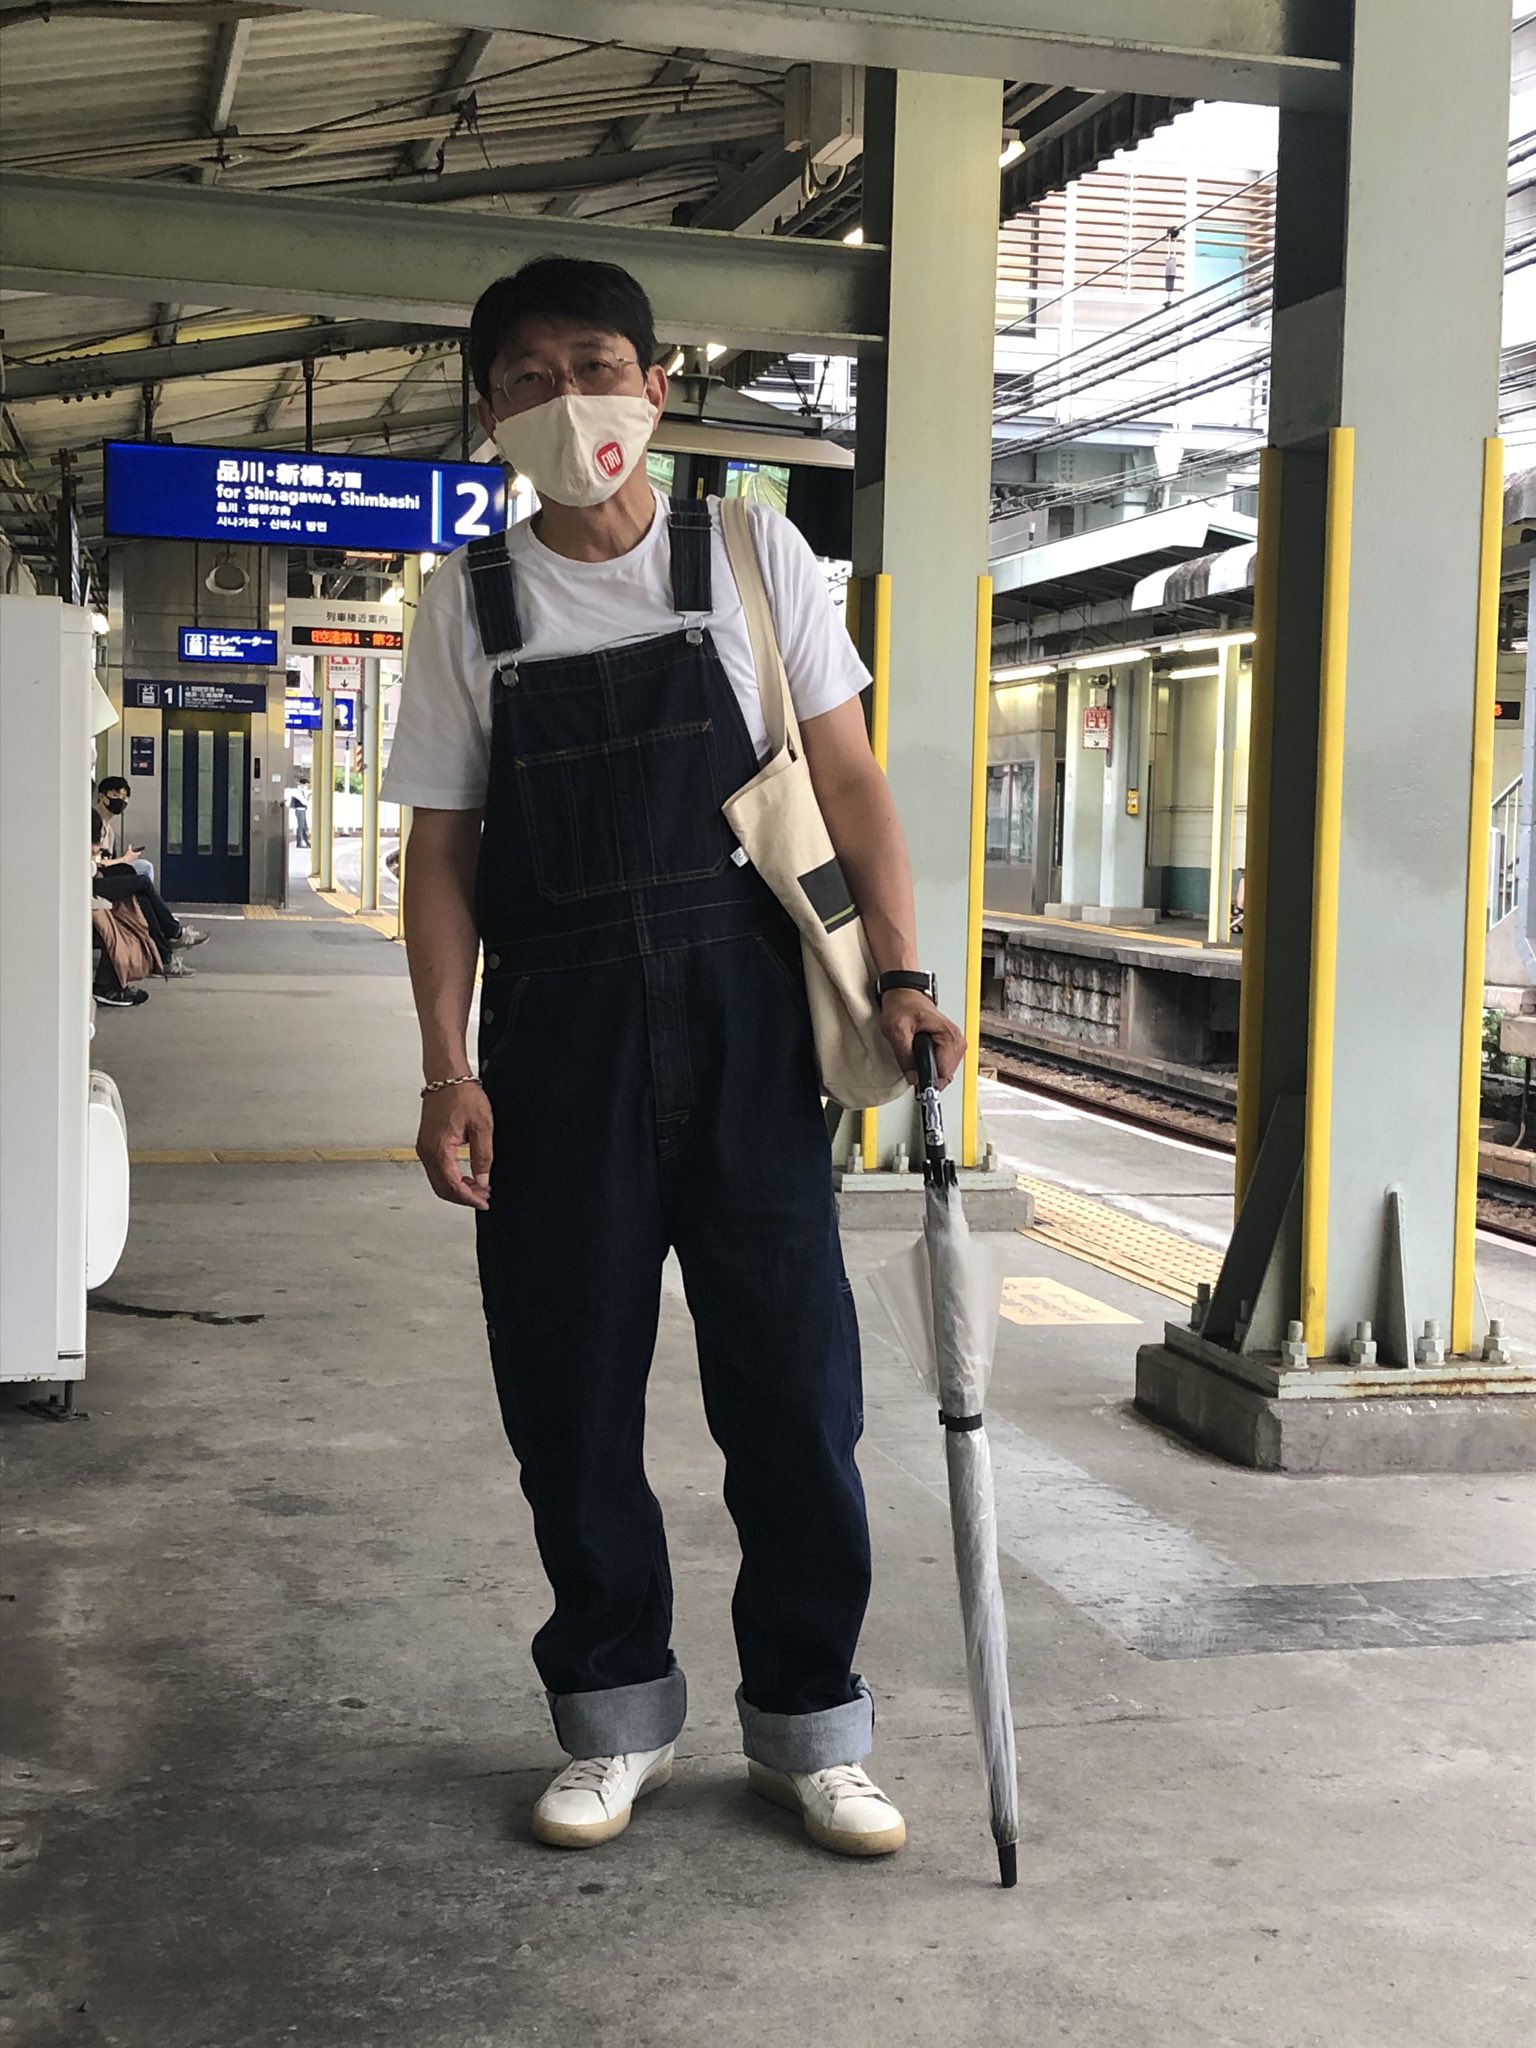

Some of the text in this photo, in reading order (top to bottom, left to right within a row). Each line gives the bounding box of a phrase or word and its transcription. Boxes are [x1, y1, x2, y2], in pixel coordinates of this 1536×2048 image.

[600, 446, 622, 472] FIAT
[216, 483, 420, 510] for Shinagawa, Shimbashi
[454, 482, 490, 536] 2
[326, 611, 388, 625] 列車接近案内
[209, 635, 273, 647] エレベーター
[164, 687, 173, 704] 1
